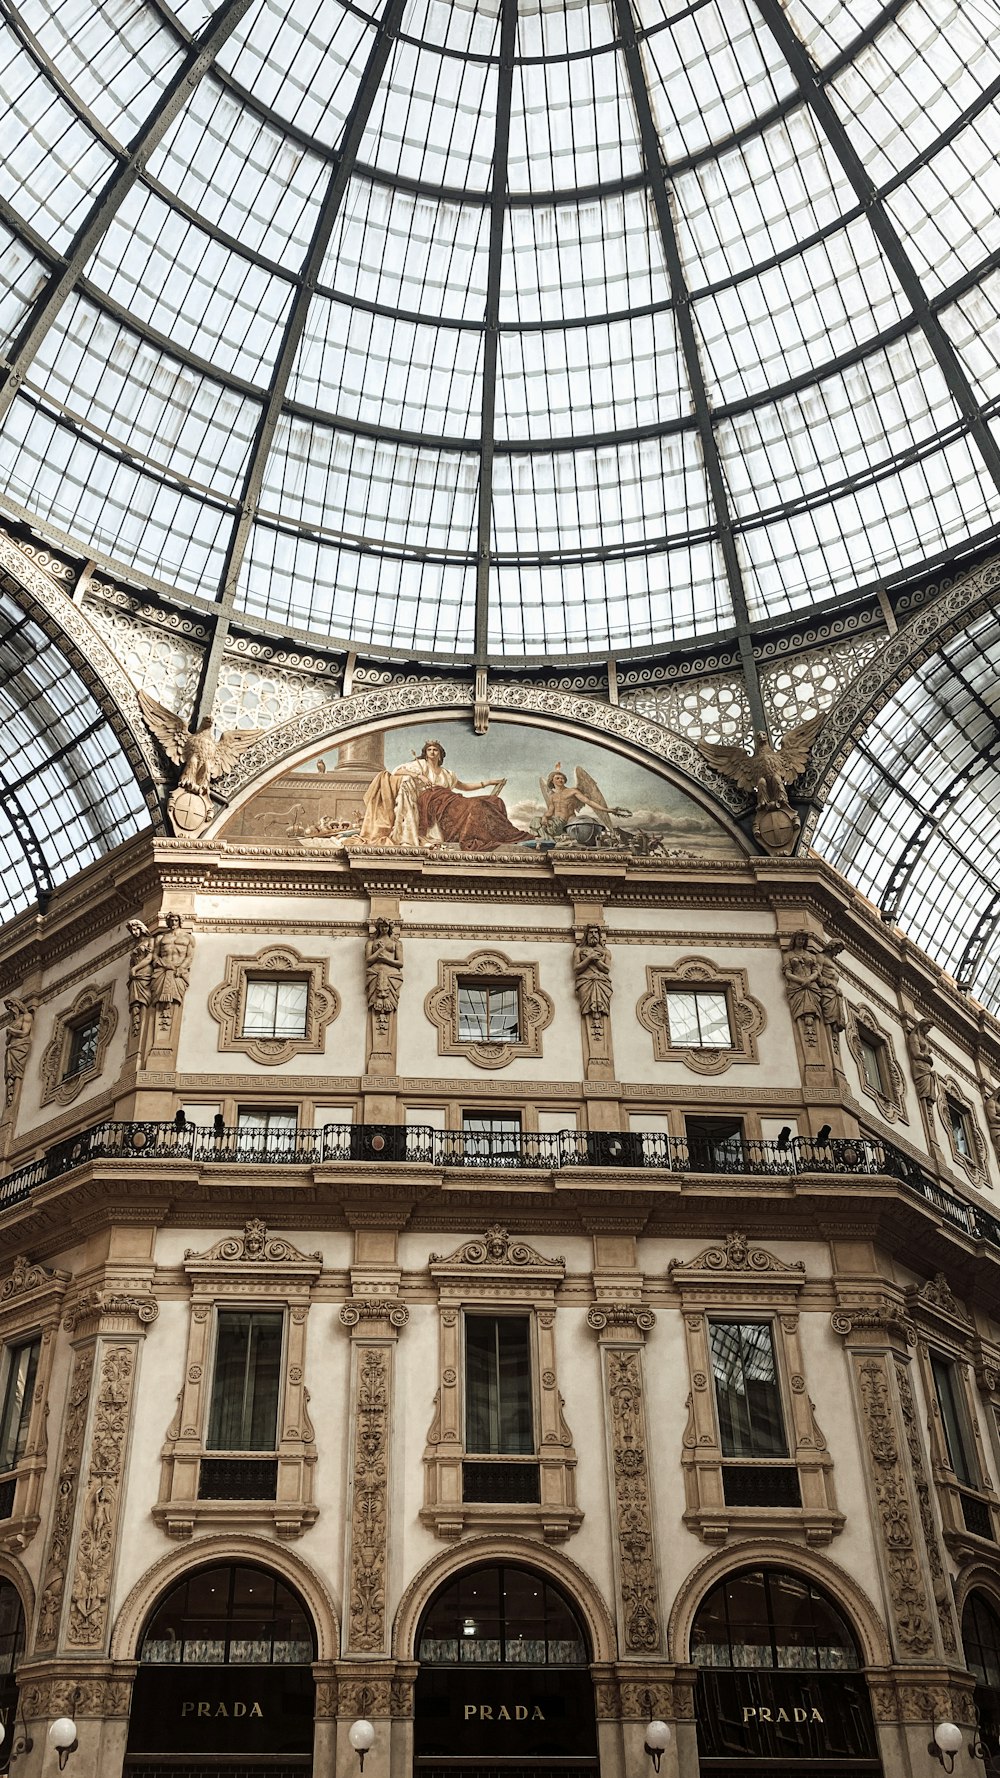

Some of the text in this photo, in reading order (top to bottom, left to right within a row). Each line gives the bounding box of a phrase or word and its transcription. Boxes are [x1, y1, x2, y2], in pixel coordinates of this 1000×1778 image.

[181, 1701, 263, 1717] PRADA
[464, 1704, 546, 1720] PRADA
[742, 1706, 823, 1722] PRADA
